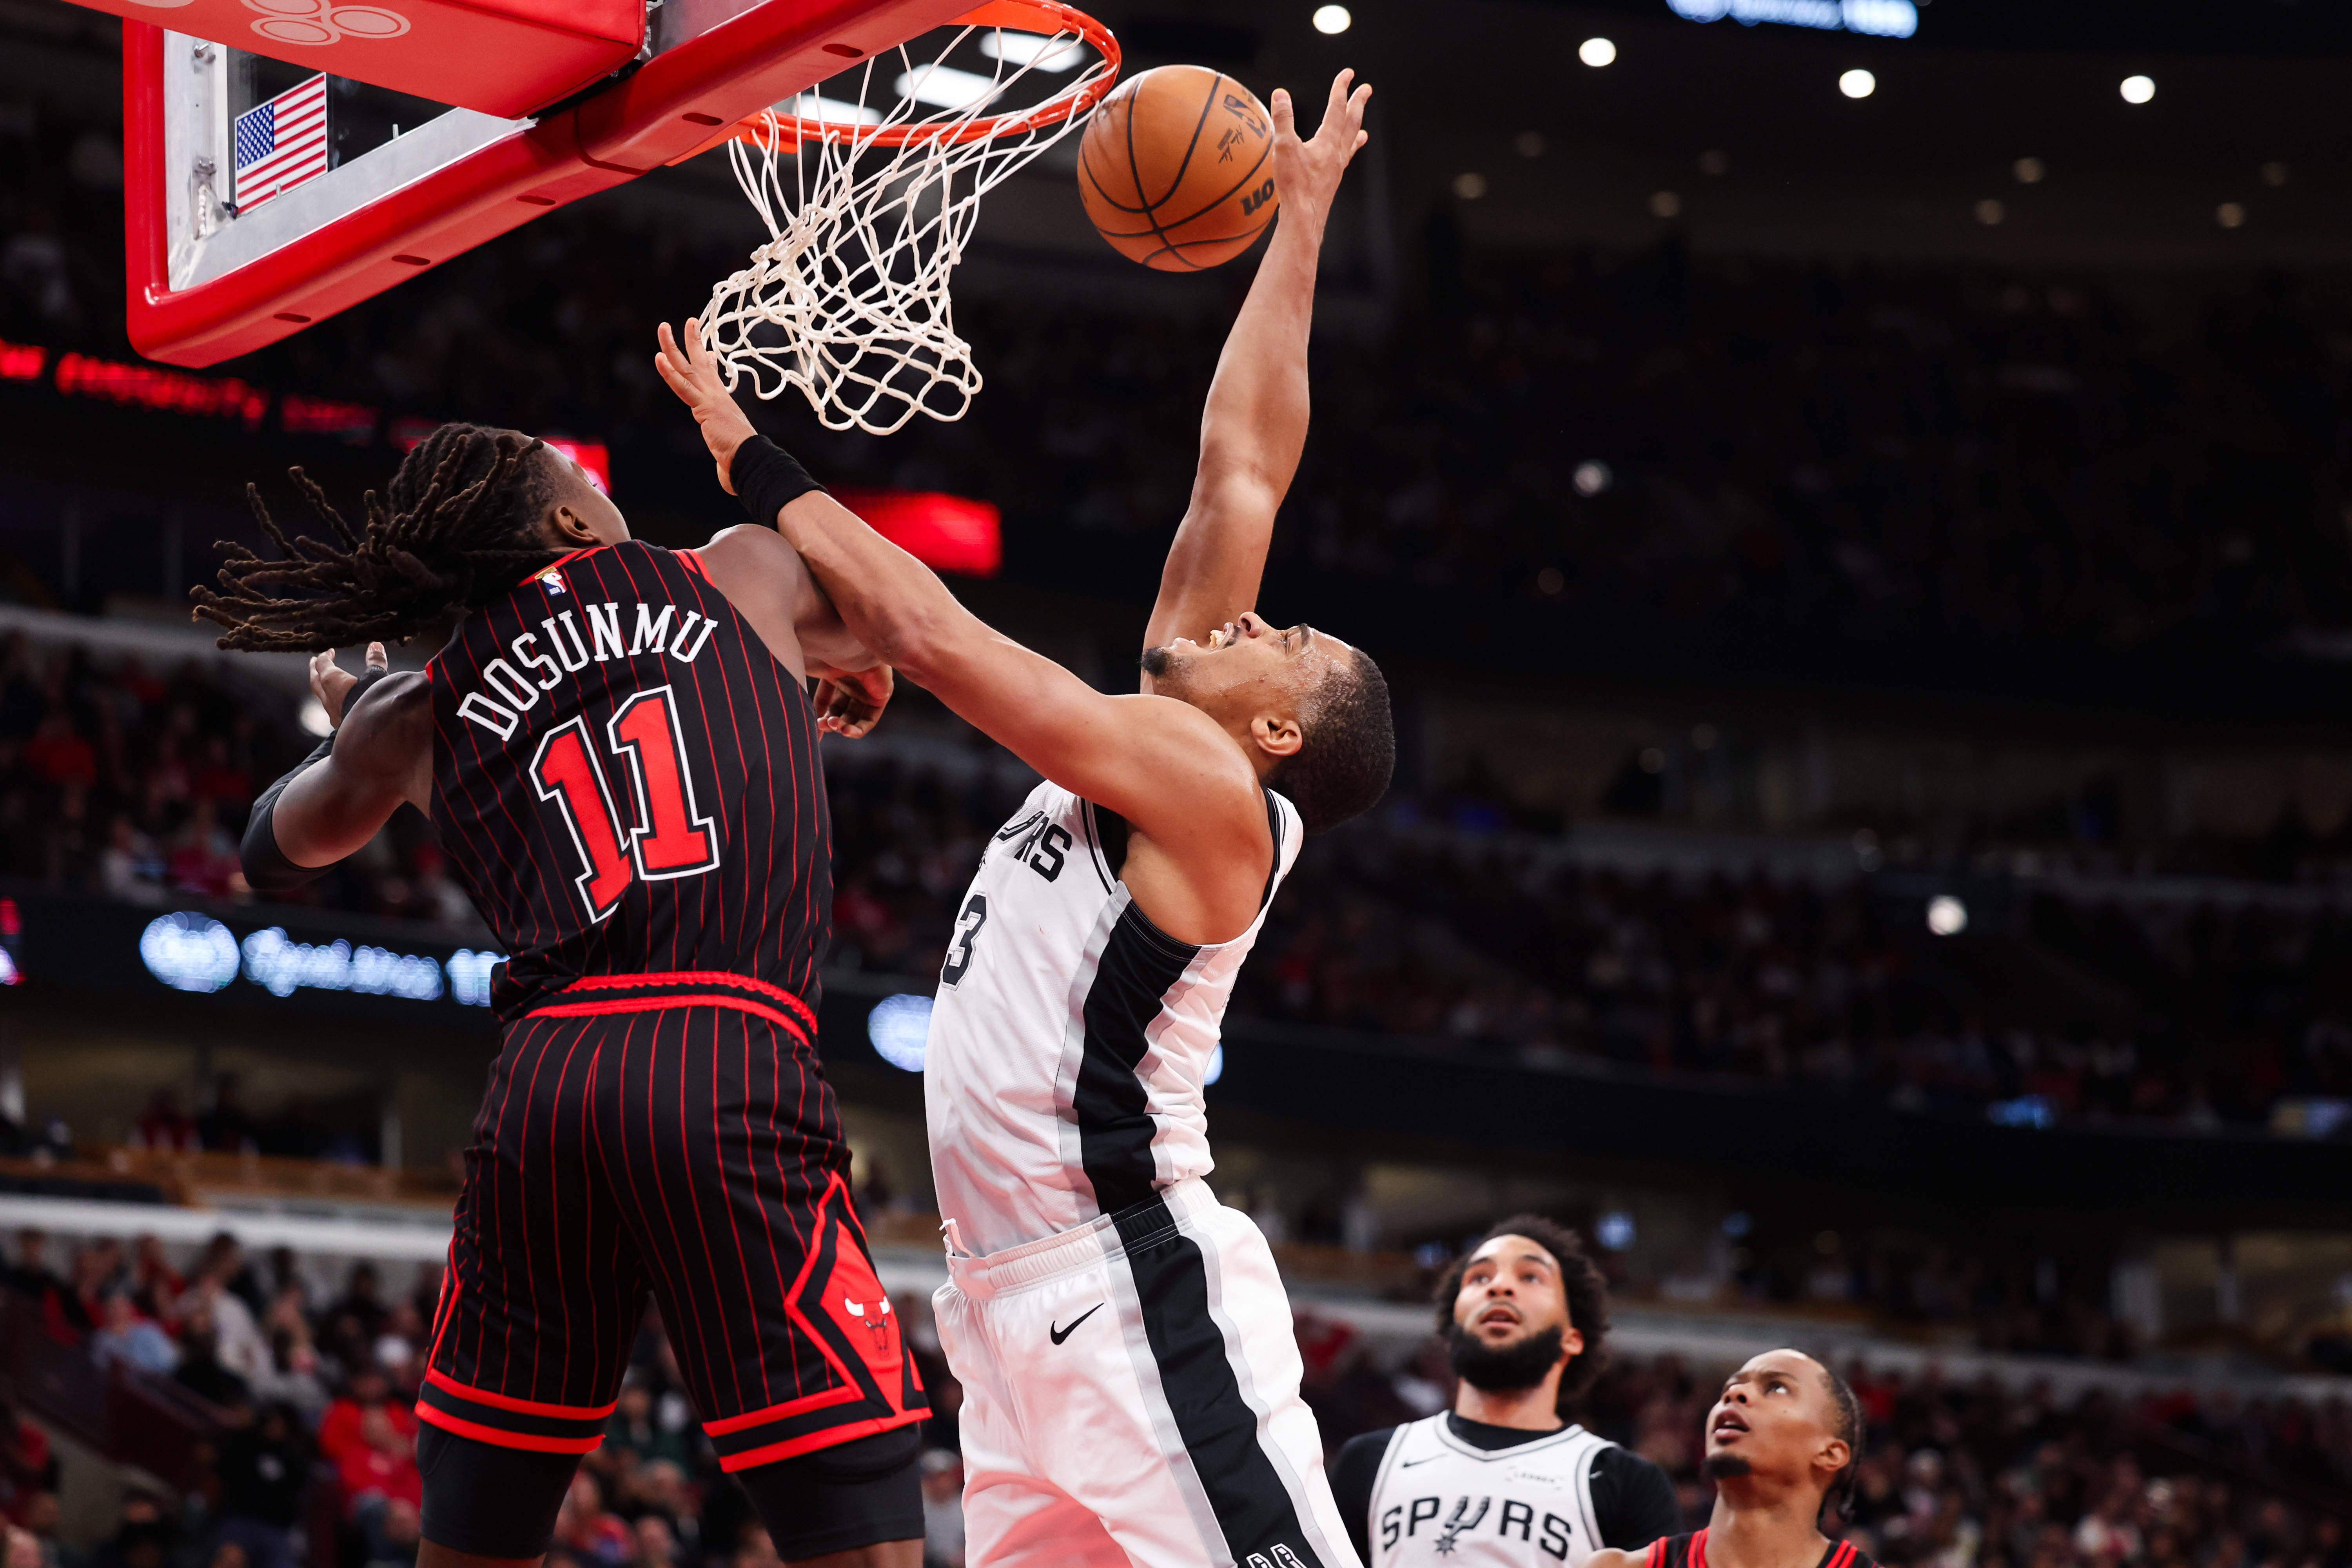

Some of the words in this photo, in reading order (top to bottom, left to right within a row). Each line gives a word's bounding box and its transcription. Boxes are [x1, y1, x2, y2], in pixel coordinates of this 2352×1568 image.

[456, 602, 718, 742] DOSUNMU
[529, 684, 720, 924] 11
[940, 891, 987, 991] 3
[1382, 1496, 1571, 1561] SPURS
